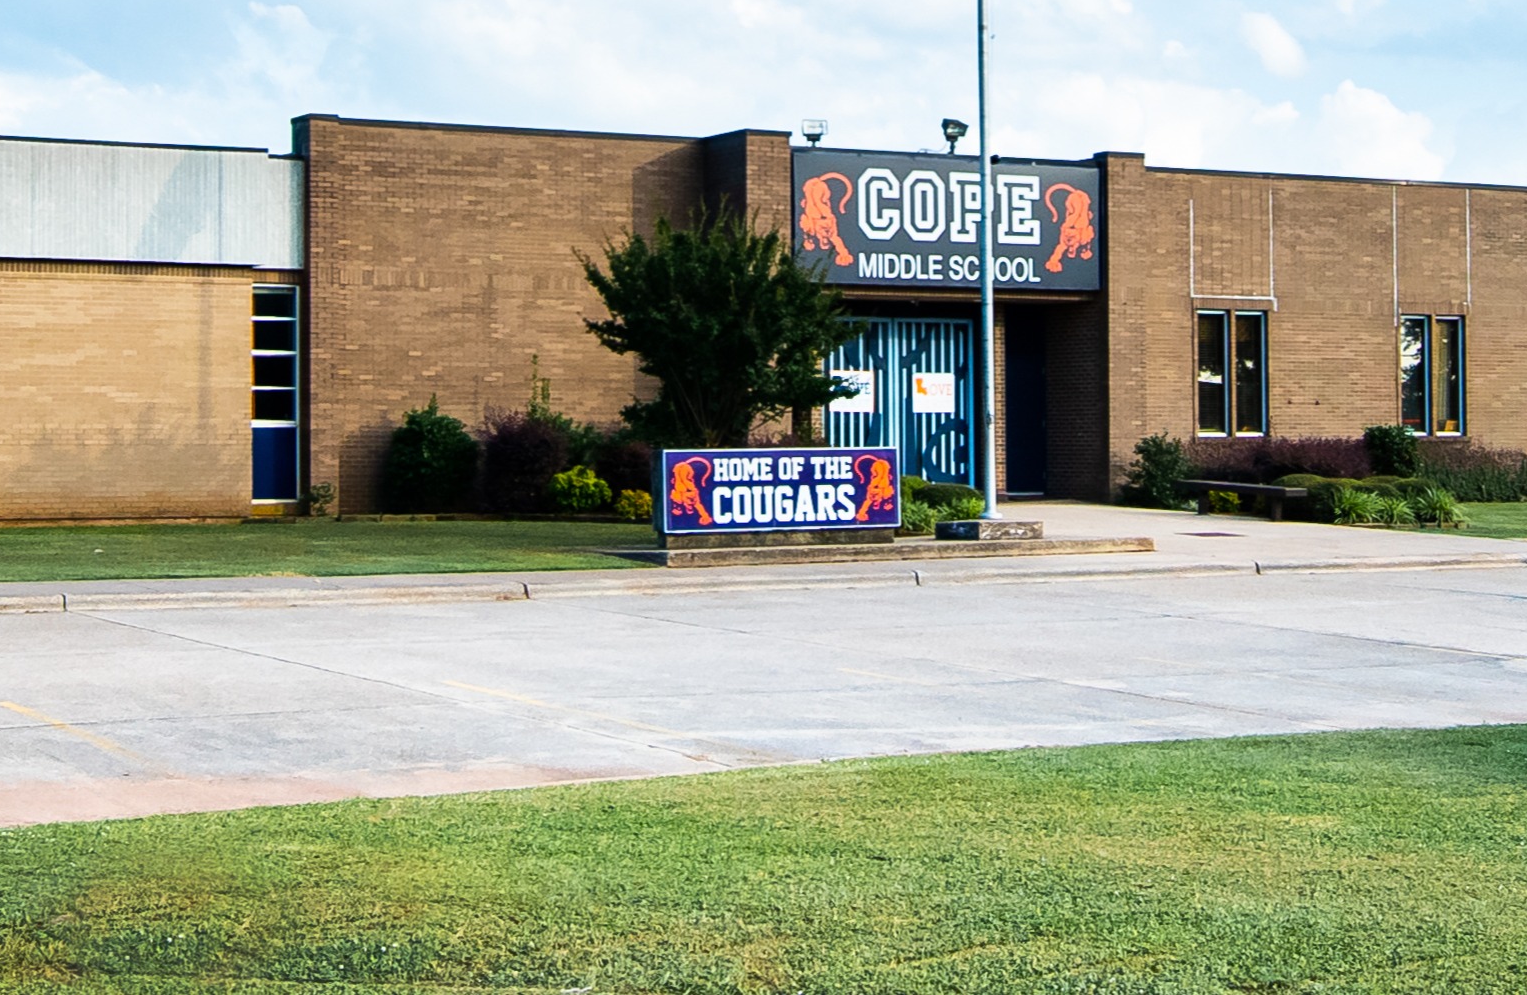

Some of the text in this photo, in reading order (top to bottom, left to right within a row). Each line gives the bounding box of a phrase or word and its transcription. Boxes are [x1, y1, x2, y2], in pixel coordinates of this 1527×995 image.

[857, 167, 1041, 245] COPE
[857, 253, 1041, 283] MIDDLE SCOOL
[713, 456, 853, 482] HOME OF THE
[712, 484, 856, 524] COUGARS
